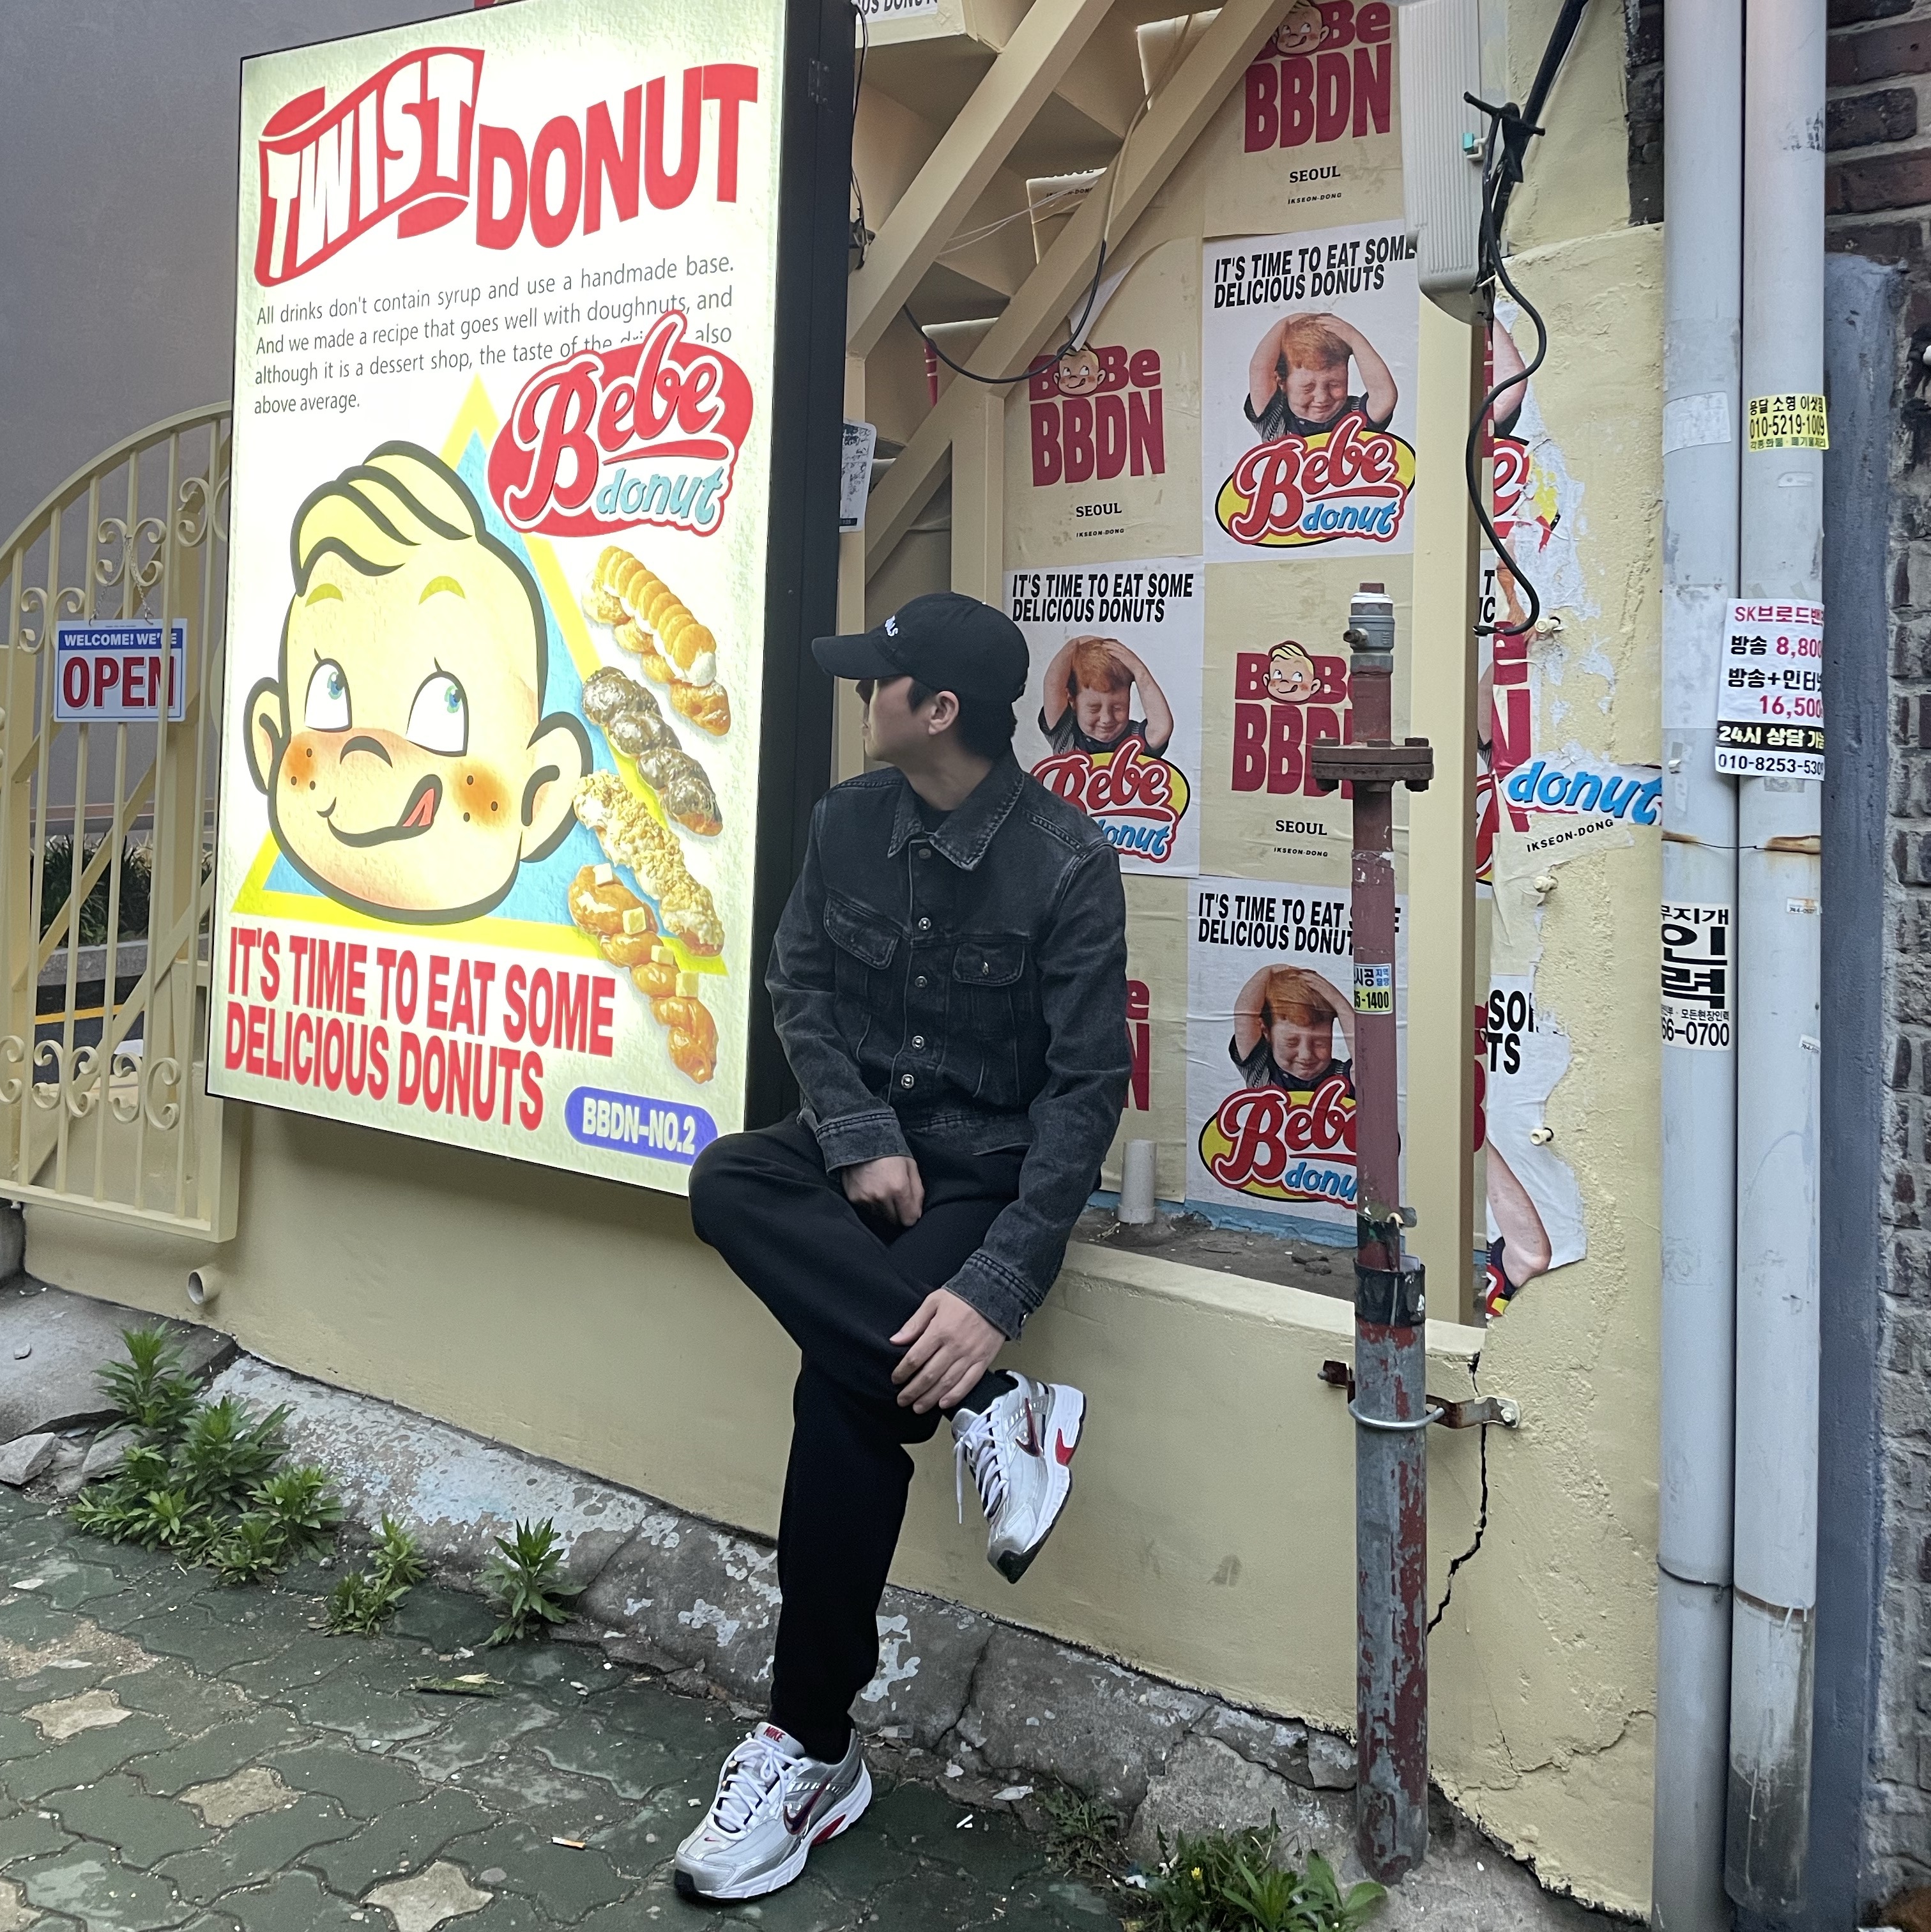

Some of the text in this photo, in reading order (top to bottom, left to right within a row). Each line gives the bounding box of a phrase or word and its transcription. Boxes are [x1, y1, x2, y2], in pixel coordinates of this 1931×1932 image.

[1244, 43, 1391, 153] BBDN
[266, 53, 758, 279] TWIST DONUT
[1289, 166, 1341, 183] SEOUL
[1288, 192, 1342, 204] IKSEON-DONG
[1214, 256, 1245, 283] IT'S
[1251, 250, 1292, 279] TIME
[1299, 247, 1321, 273] TO
[1326, 241, 1361, 269] EAT
[257, 255, 733, 325] All drinks don't contain syrup and use a handmade base.
[1214, 264, 1385, 309] DELICIOUS DONUTS
[256, 285, 732, 355] And we made a recipe that goes well with doughnuts, and
[256, 362, 317, 385] although
[324, 361, 333, 379] it
[340, 360, 349, 378] is
[356, 362, 363, 376] a
[370, 355, 424, 374] dessert
[431, 349, 473, 372] shop,
[480, 345, 505, 365] the
[513, 342, 553, 362] taste
[560, 335, 578, 358] of
[696, 323, 732, 344] also
[254, 394, 360, 414] above average.
[510, 321, 719, 521] Bebe
[1030, 388, 1165, 487] BBDN
[597, 467, 722, 524] donut
[1235, 417, 1393, 537] Bebe
[1076, 502, 1122, 518] SEOUL
[1303, 502, 1398, 534] donut
[1076, 528, 1124, 538] IKSEON-DONG
[1012, 573, 1194, 598] IT'S TIME TO EAT SOME
[1012, 599, 1166, 623] DELICIOUS DONUTS
[65, 632, 177, 647] WELCOME! WE'E
[1731, 636, 1767, 655] 방송
[63, 656, 174, 708] OPEN
[1232, 703, 1354, 800] BBD
[1719, 726, 1761, 745] 24시
[1767, 727, 1805, 747] 상담
[1508, 761, 1662, 825] donut
[1099, 819, 1170, 857] onut
[1276, 820, 1327, 836] SEOUL
[1527, 818, 1614, 853] IKSEON-DONG
[1274, 847, 1328, 857] IKSEON-DONG
[1199, 893, 1229, 920] IT'S
[1235, 895, 1276, 923] TIME
[1282, 899, 1305, 924] TO
[1310, 901, 1345, 928] EAT
[1198, 918, 1289, 950] DELICIOUS
[229, 926, 614, 1057] IT'S TIME TO EAT SOME
[225, 1001, 543, 1131] DELICIOUS DONUTS
[583, 1096, 696, 1155] BBDN-NO.2
[1285, 1162, 1358, 1201] donu
[763, 1726, 786, 1742] NIKE
